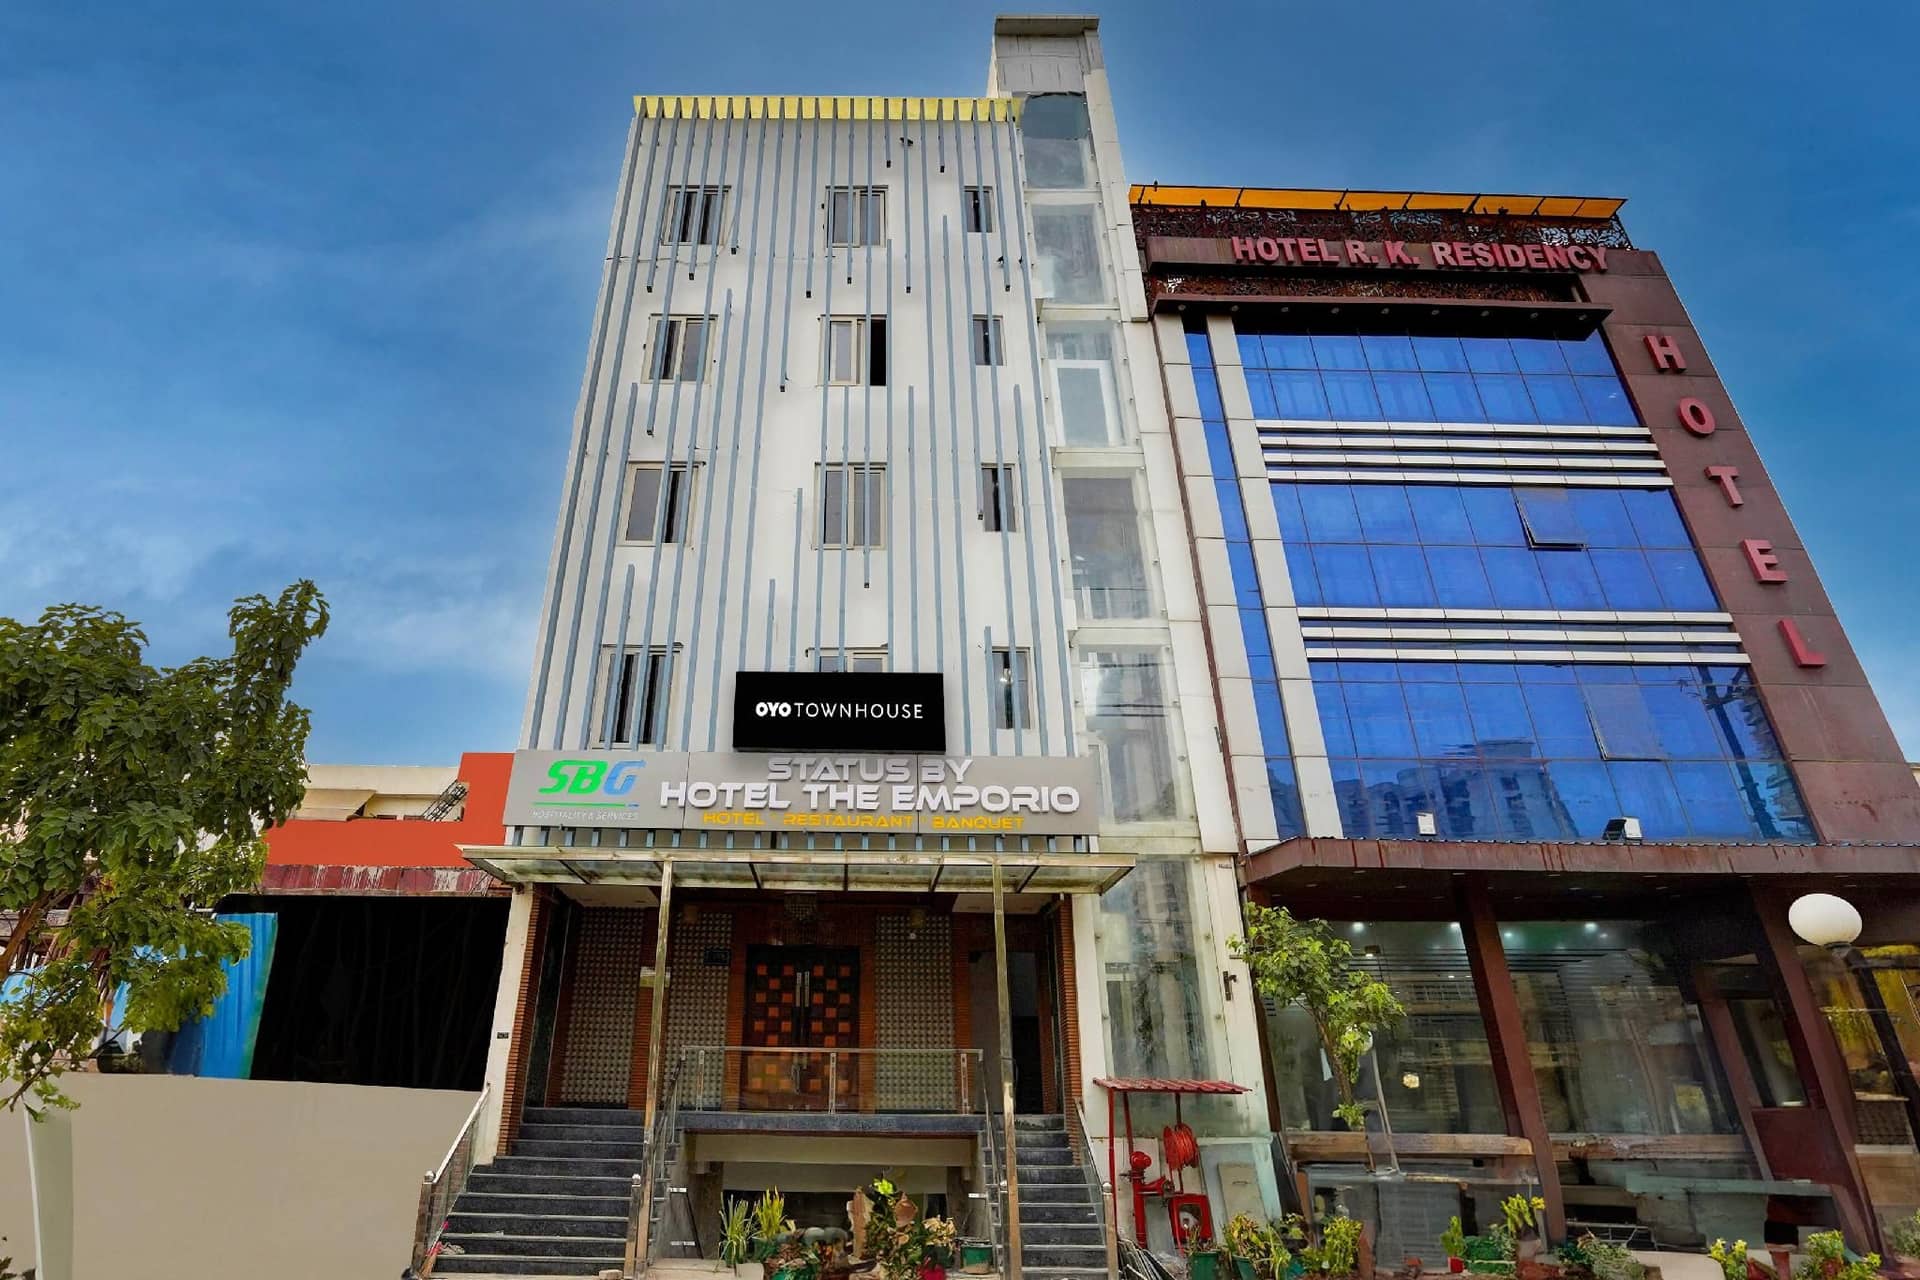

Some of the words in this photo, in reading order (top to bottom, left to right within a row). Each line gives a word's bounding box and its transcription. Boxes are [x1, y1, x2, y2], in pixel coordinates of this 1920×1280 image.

[1231, 235, 1340, 265] HOTEL
[1344, 239, 1380, 266] R.
[1383, 240, 1421, 268] K.
[1431, 242, 1609, 273] RESIDENCY
[1643, 335, 1825, 668] HOTEL
[755, 702, 792, 717] OYO
[793, 702, 923, 719] TOWNHOUSE
[538, 759, 647, 796] SBG
[767, 757, 911, 782] STATUS
[920, 759, 974, 783] BY
[660, 781, 792, 809] HOTEL
[802, 784, 881, 811] THE
[891, 785, 1080, 813] EMPORIO
[703, 812, 765, 825] HOTEL
[783, 813, 913, 828] RESTAURANT
[931, 816, 1025, 829] BANQUET
